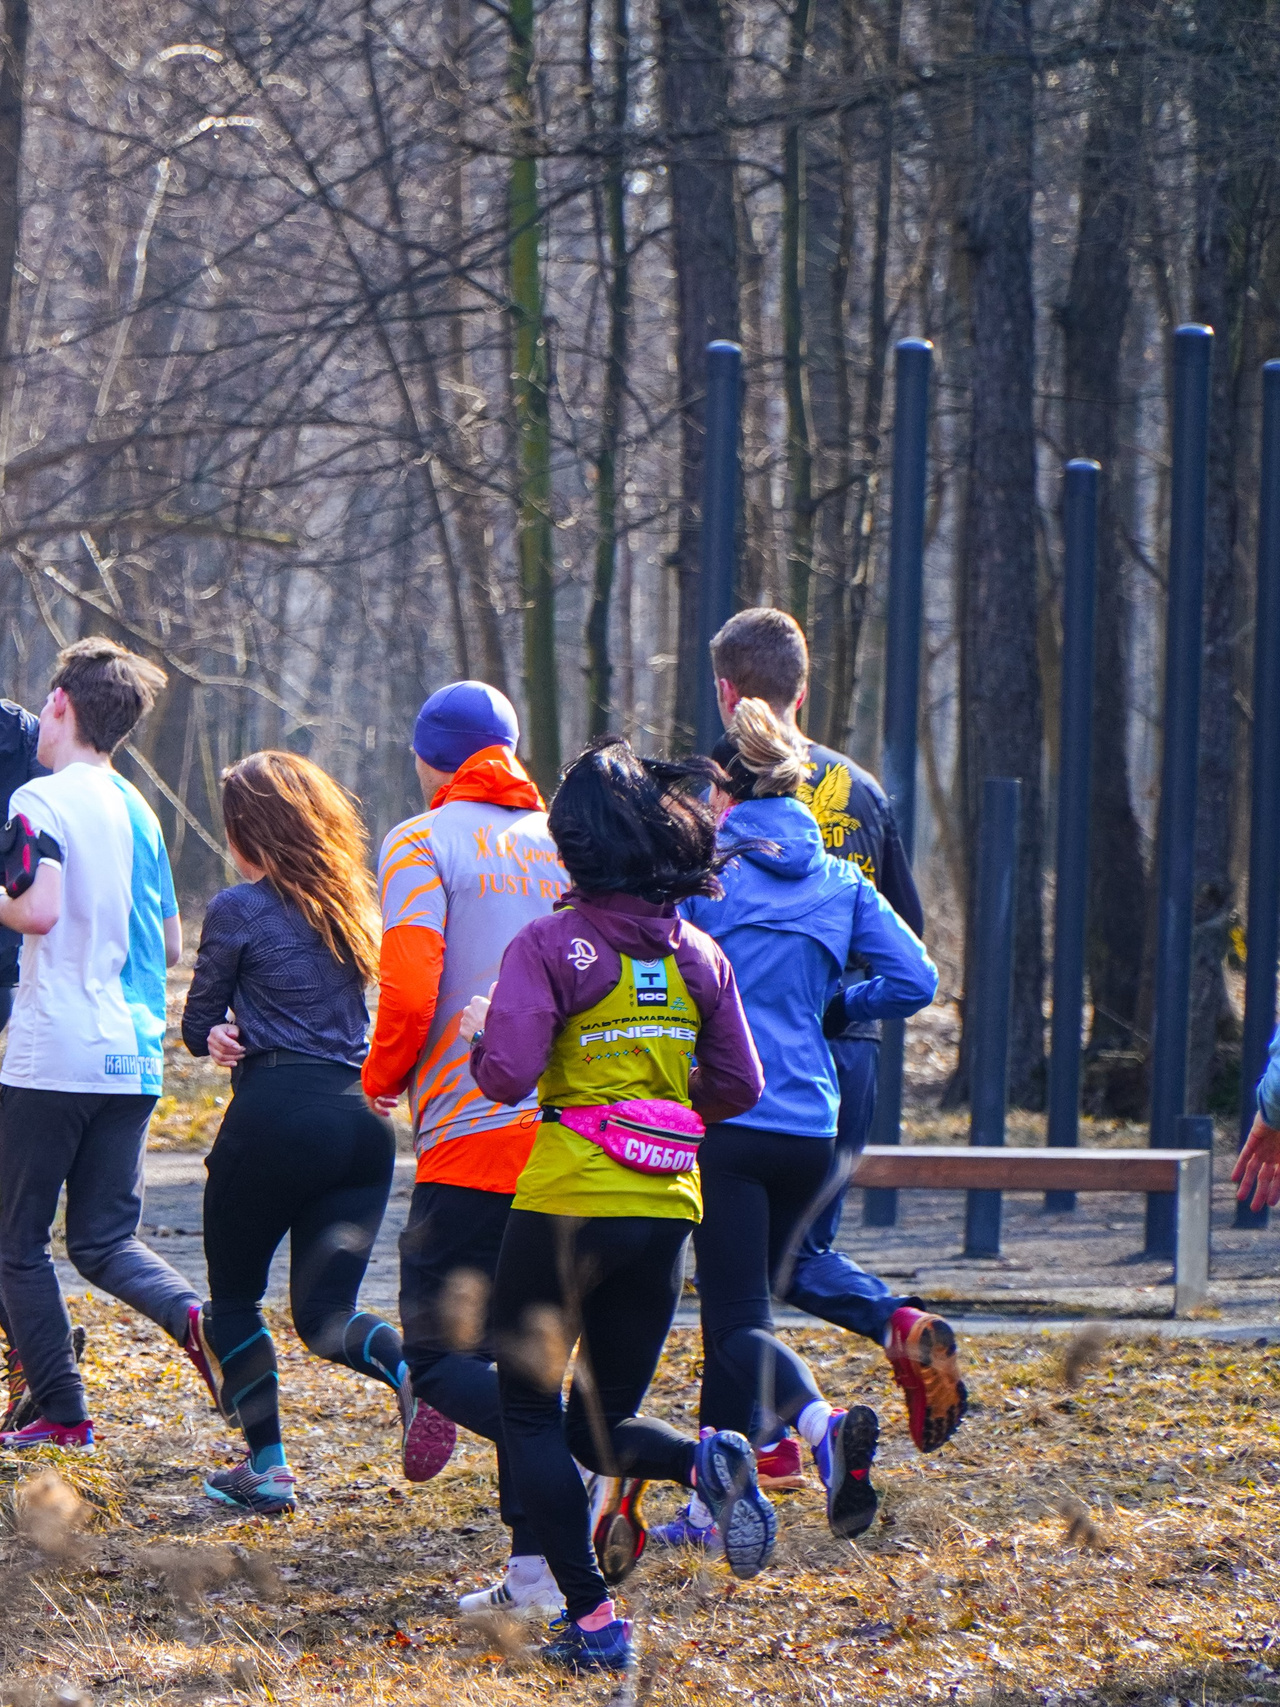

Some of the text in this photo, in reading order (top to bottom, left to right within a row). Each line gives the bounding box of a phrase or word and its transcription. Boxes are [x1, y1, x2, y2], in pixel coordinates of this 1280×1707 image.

[477, 873, 572, 900] JUST RU
[640, 972, 661, 986] T
[637, 992, 667, 1002] 100
